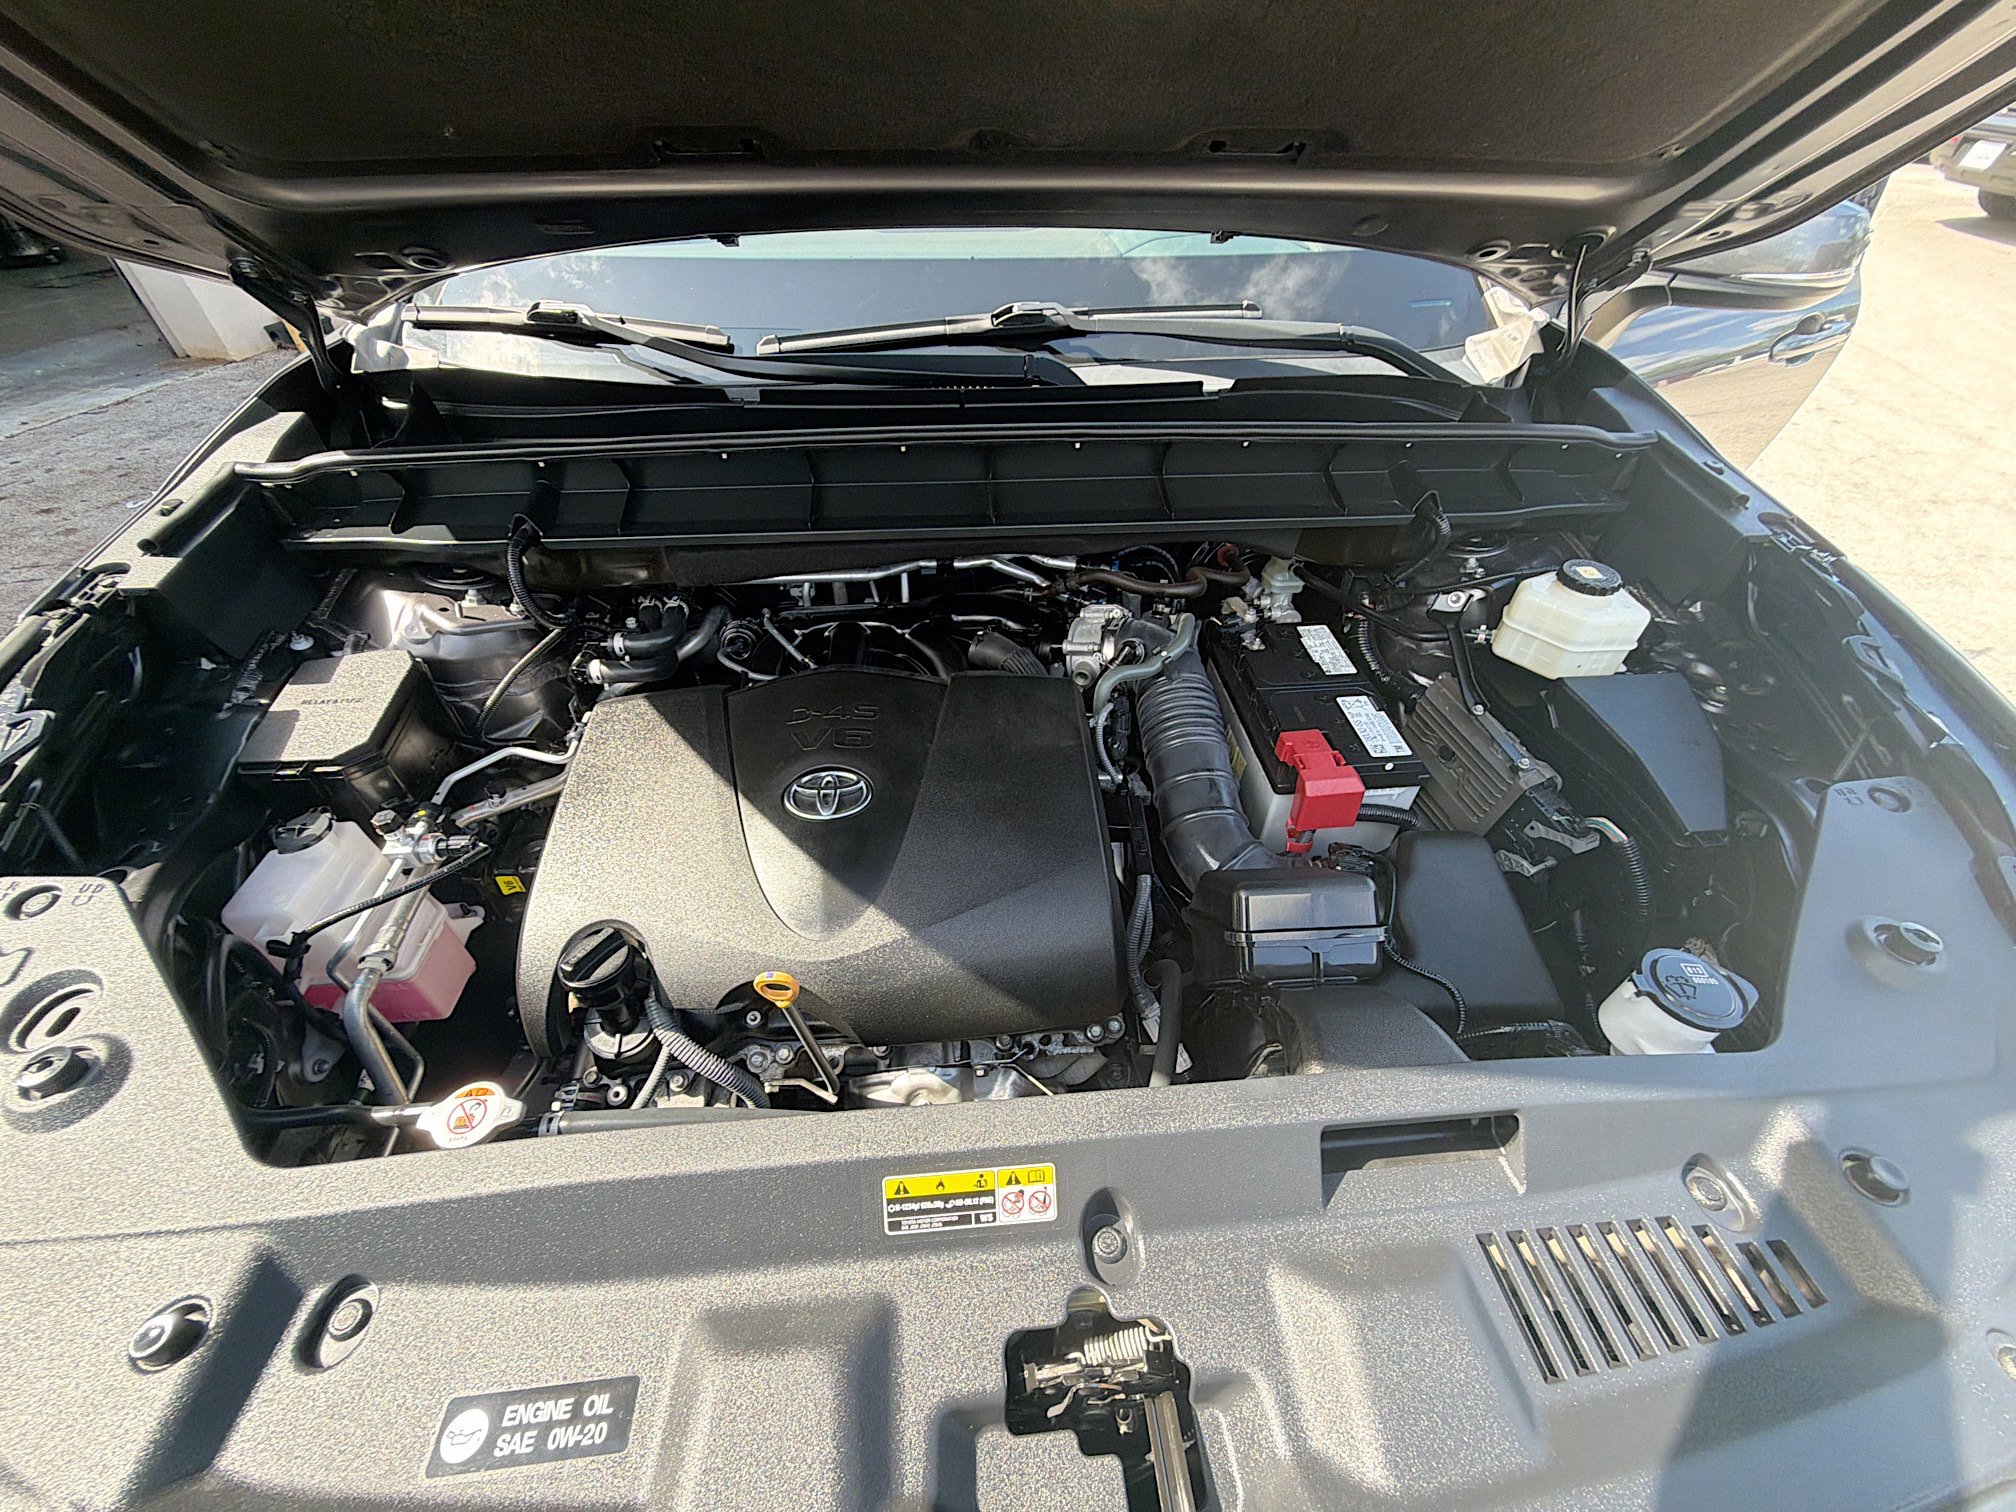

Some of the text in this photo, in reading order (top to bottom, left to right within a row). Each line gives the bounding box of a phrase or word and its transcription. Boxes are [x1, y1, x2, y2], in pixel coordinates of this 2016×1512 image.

[790, 727, 875, 751] V6
[979, 1213, 994, 1223] WS
[500, 1392, 614, 1428] ENGINE OIL
[493, 1422, 608, 1458] SAE 0W-20
